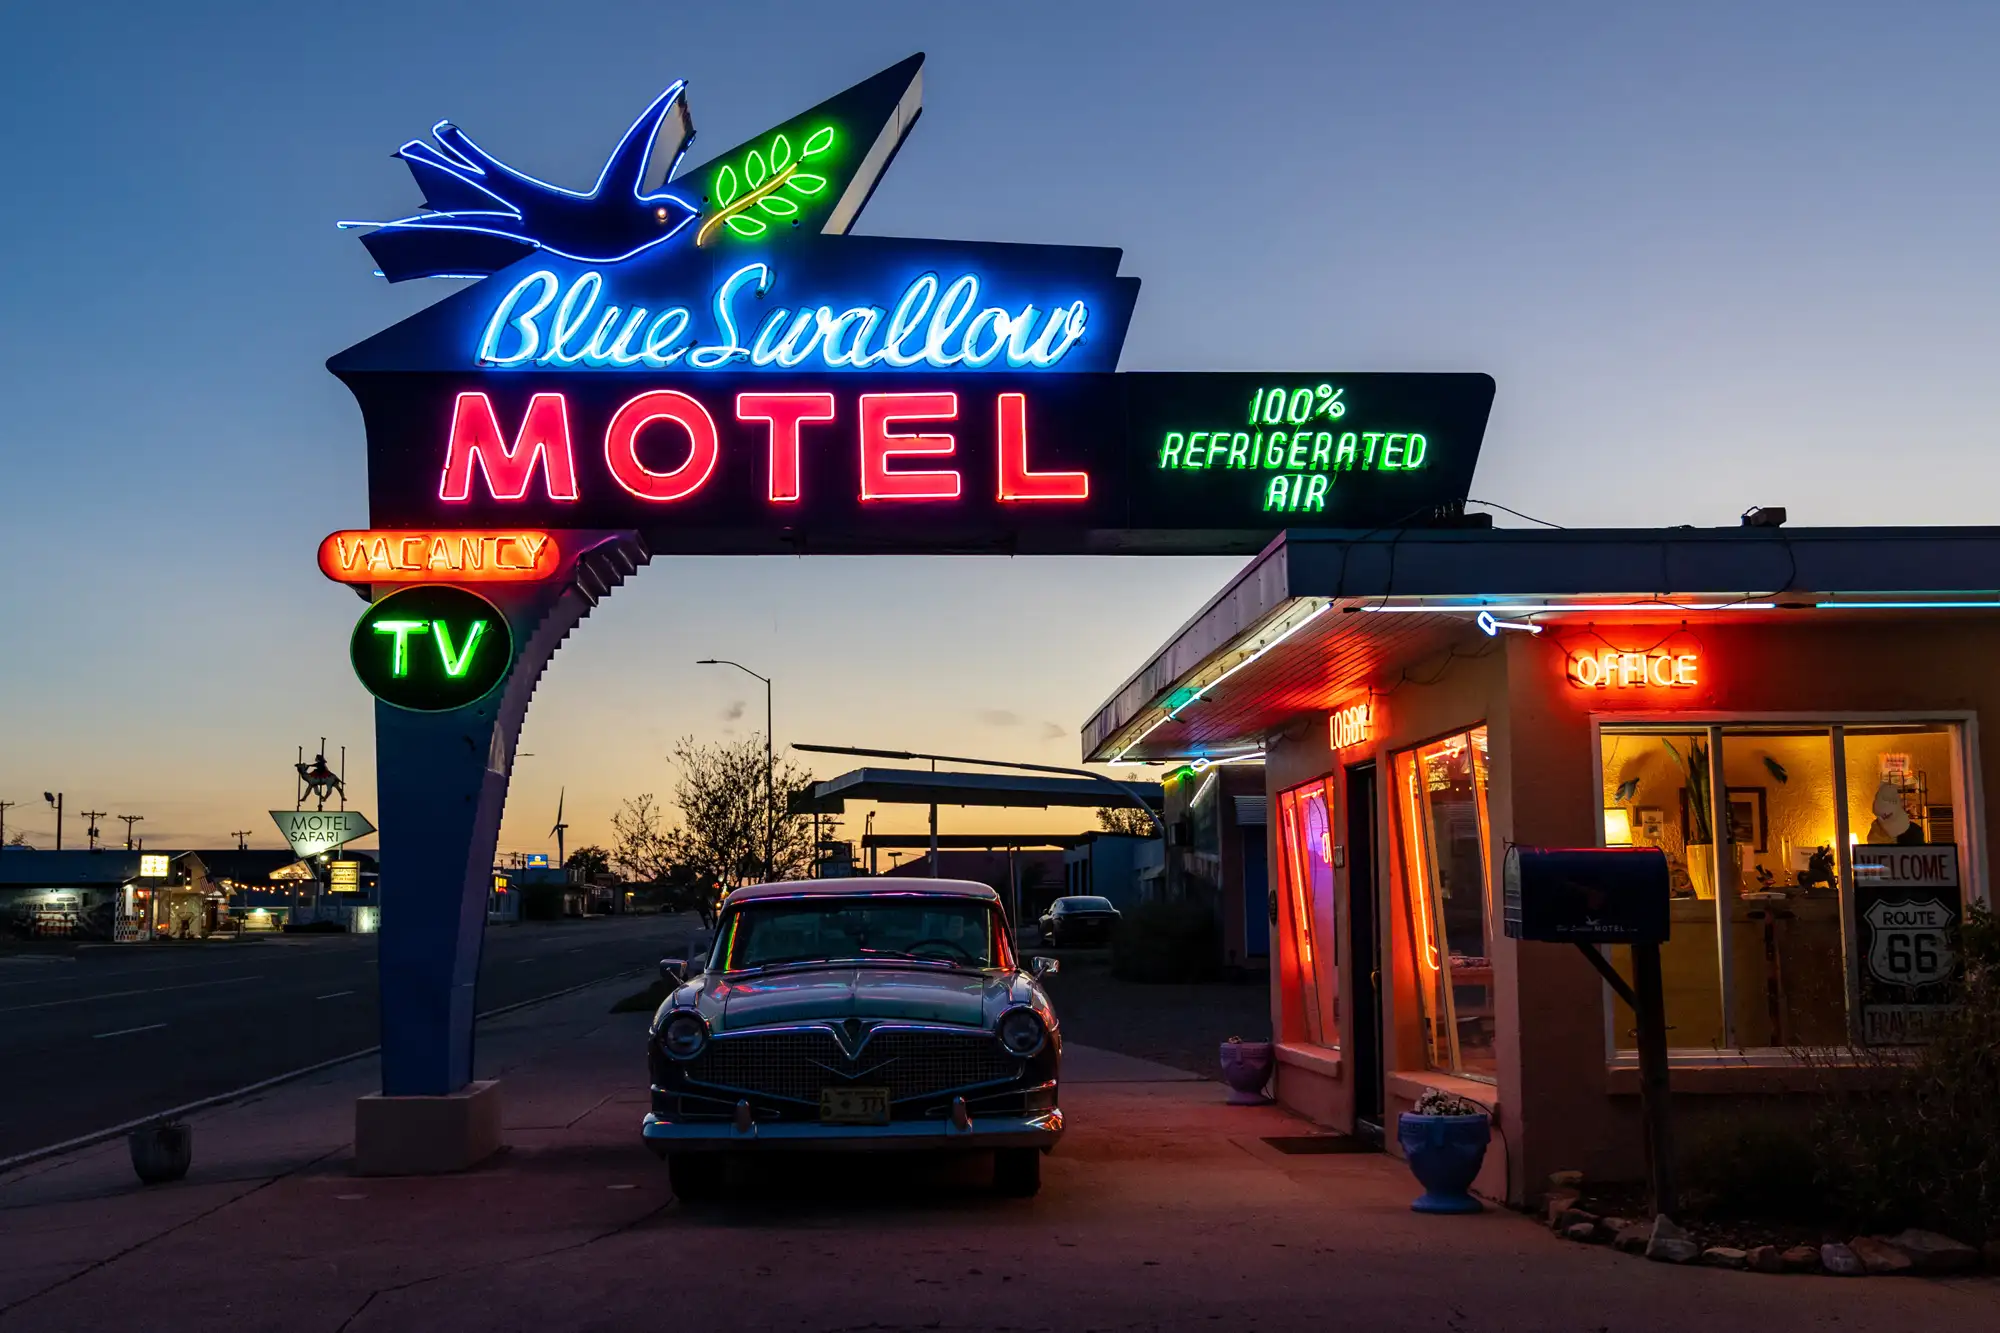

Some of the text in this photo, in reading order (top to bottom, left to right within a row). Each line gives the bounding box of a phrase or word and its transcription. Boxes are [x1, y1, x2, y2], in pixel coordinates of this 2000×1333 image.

[473, 262, 1088, 367] Blue Swallow
[1250, 384, 1345, 424] 100%
[438, 389, 1090, 501] MOTEL
[1159, 432, 1427, 471] REFRIGERATED
[1264, 474, 1327, 512] AIR
[336, 534, 550, 571] VACANCY
[372, 620, 488, 678] TV
[1569, 650, 1698, 688] OFFICE
[290, 816, 352, 831] MOTEL
[290, 831, 339, 842] SAFARI
[1859, 854, 1950, 882] WELCOME
[1593, 924, 1626, 933] MOTEL
[1883, 911, 1937, 926] ROUTE
[1888, 933, 1938, 974] 66
